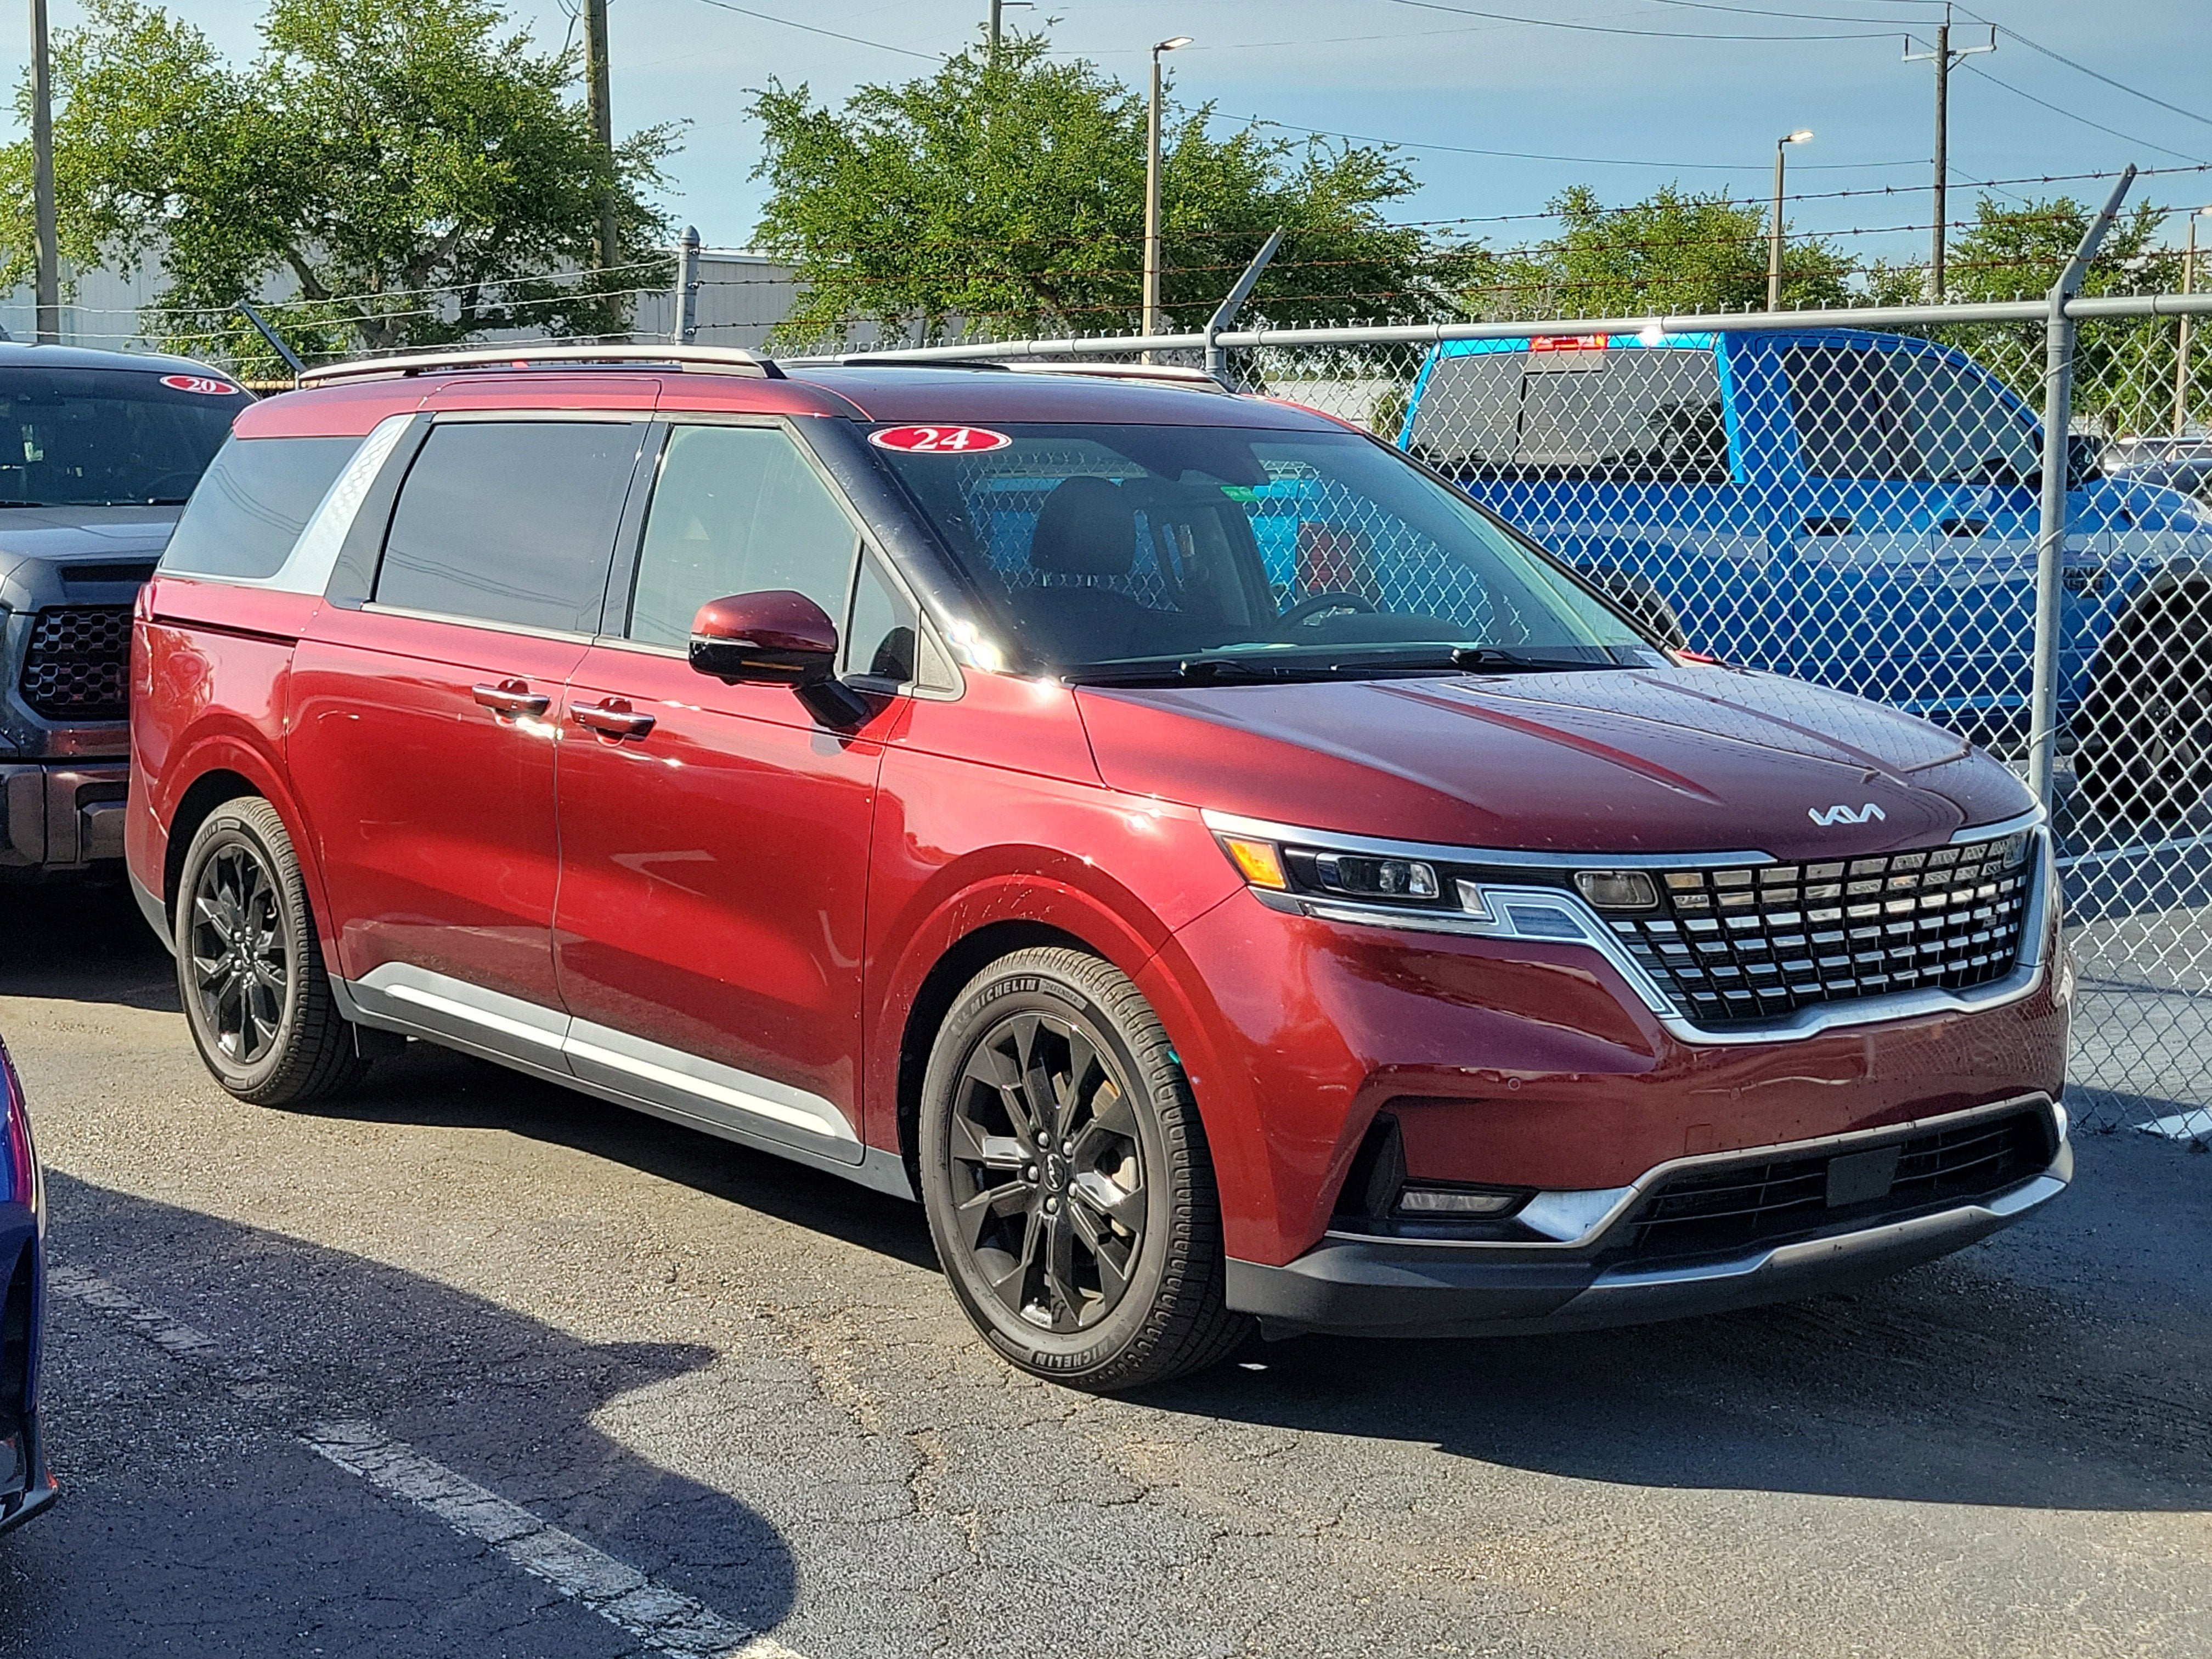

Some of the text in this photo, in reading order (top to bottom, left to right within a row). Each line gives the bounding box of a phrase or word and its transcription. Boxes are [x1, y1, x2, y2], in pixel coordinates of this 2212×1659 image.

[187, 379, 217, 392] 20
[910, 428, 970, 450] 24
[1808, 803, 1886, 826] KIA
[970, 979, 1036, 1014] MICHELIN
[1036, 1339, 1108, 1368] MICHELIN
